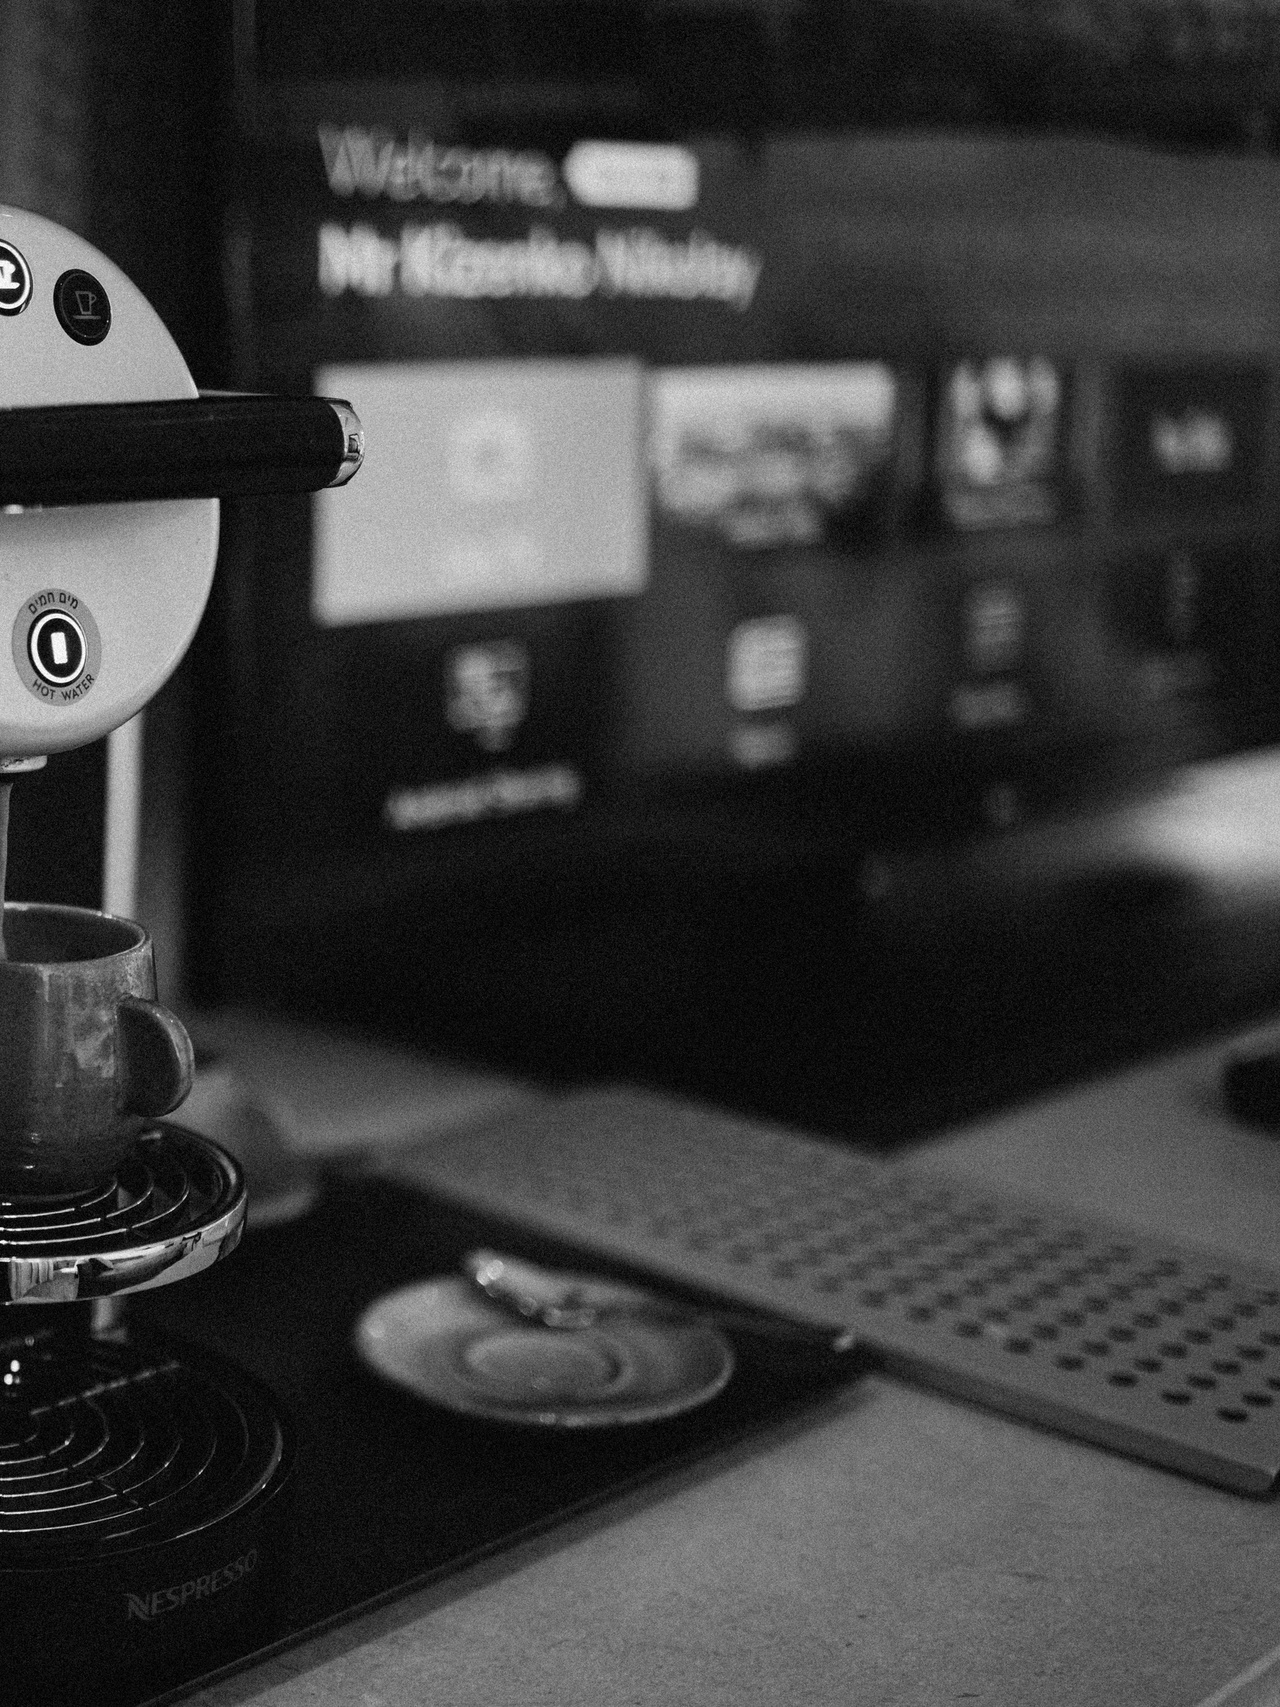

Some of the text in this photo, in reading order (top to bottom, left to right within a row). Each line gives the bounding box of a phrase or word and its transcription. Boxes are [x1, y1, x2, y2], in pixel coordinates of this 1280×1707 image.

[320, 222, 396, 297] Mr
[28, 592, 78, 614] מים חמים
[32, 674, 94, 700] HOT WATER
[123, 1550, 257, 1620] NESPRESSO
